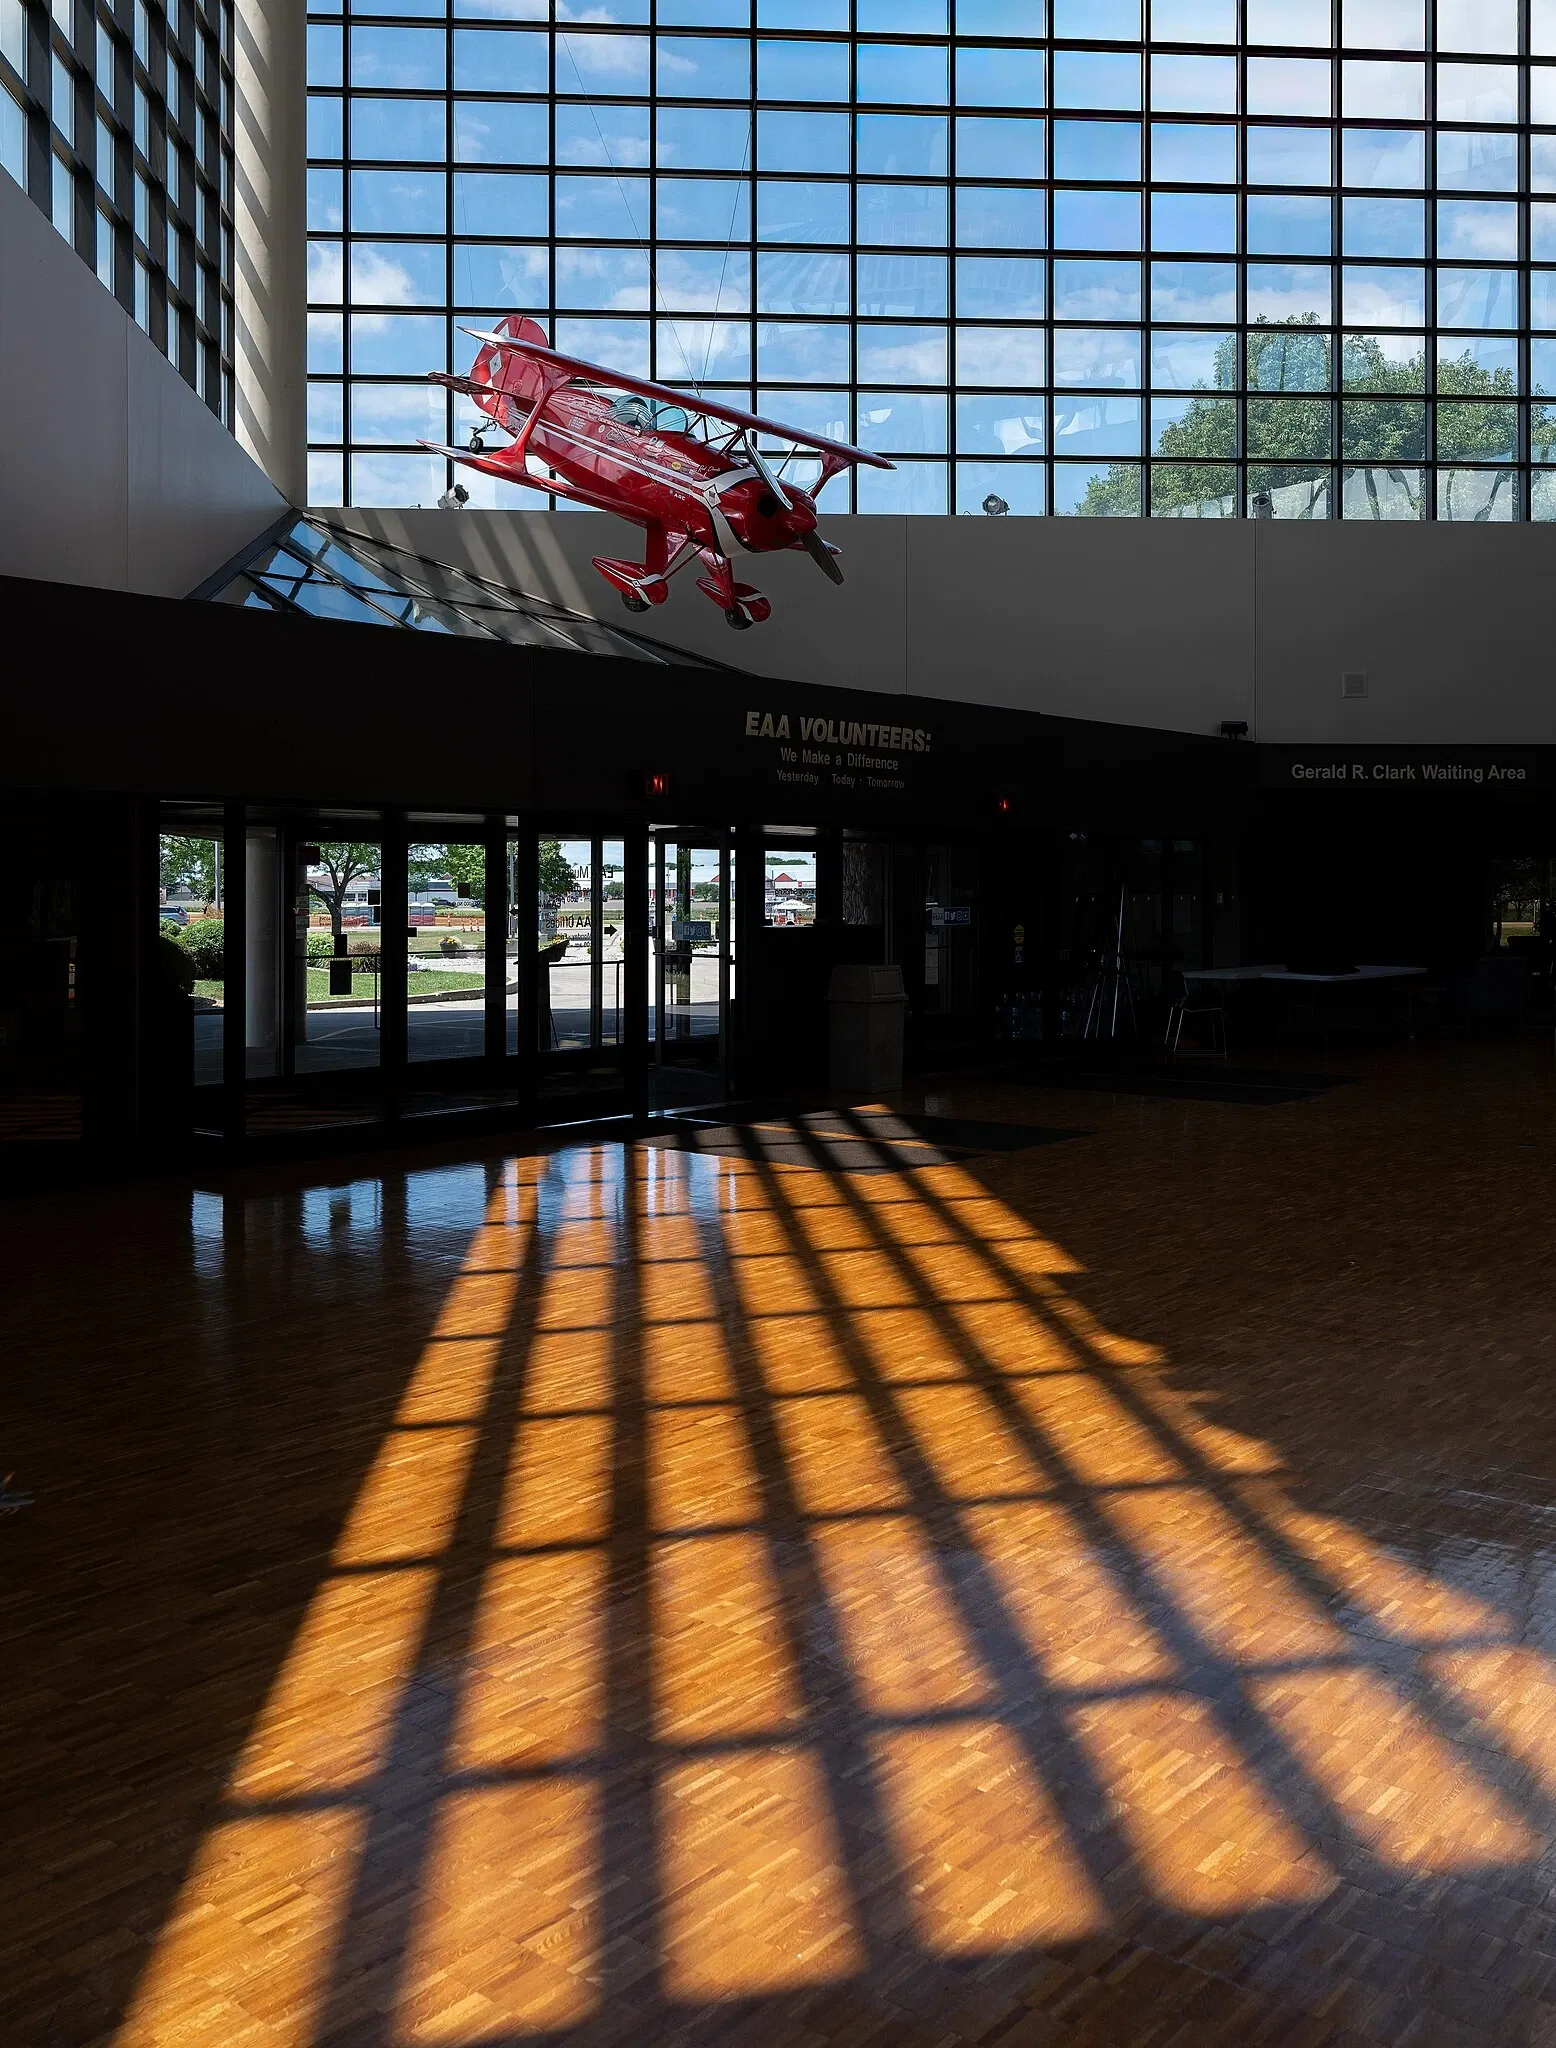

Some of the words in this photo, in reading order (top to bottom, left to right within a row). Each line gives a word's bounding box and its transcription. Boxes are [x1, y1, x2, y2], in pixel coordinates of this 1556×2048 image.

[745, 711, 791, 739] EAA
[800, 716, 932, 752] VOLUNTEERS:
[780, 747, 797, 763] We
[802, 749, 830, 766] Make
[835, 755, 842, 766] a
[847, 753, 899, 770] Difference
[776, 769, 819, 786] Yesterday
[831, 773, 856, 788] Today
[866, 776, 905, 789] Tomorrow
[1291, 763, 1347, 780] Gerald
[1352, 764, 1369, 780] R.
[1372, 764, 1416, 780] Clark
[1422, 764, 1483, 783] Waiting
[1487, 764, 1526, 780] Area
